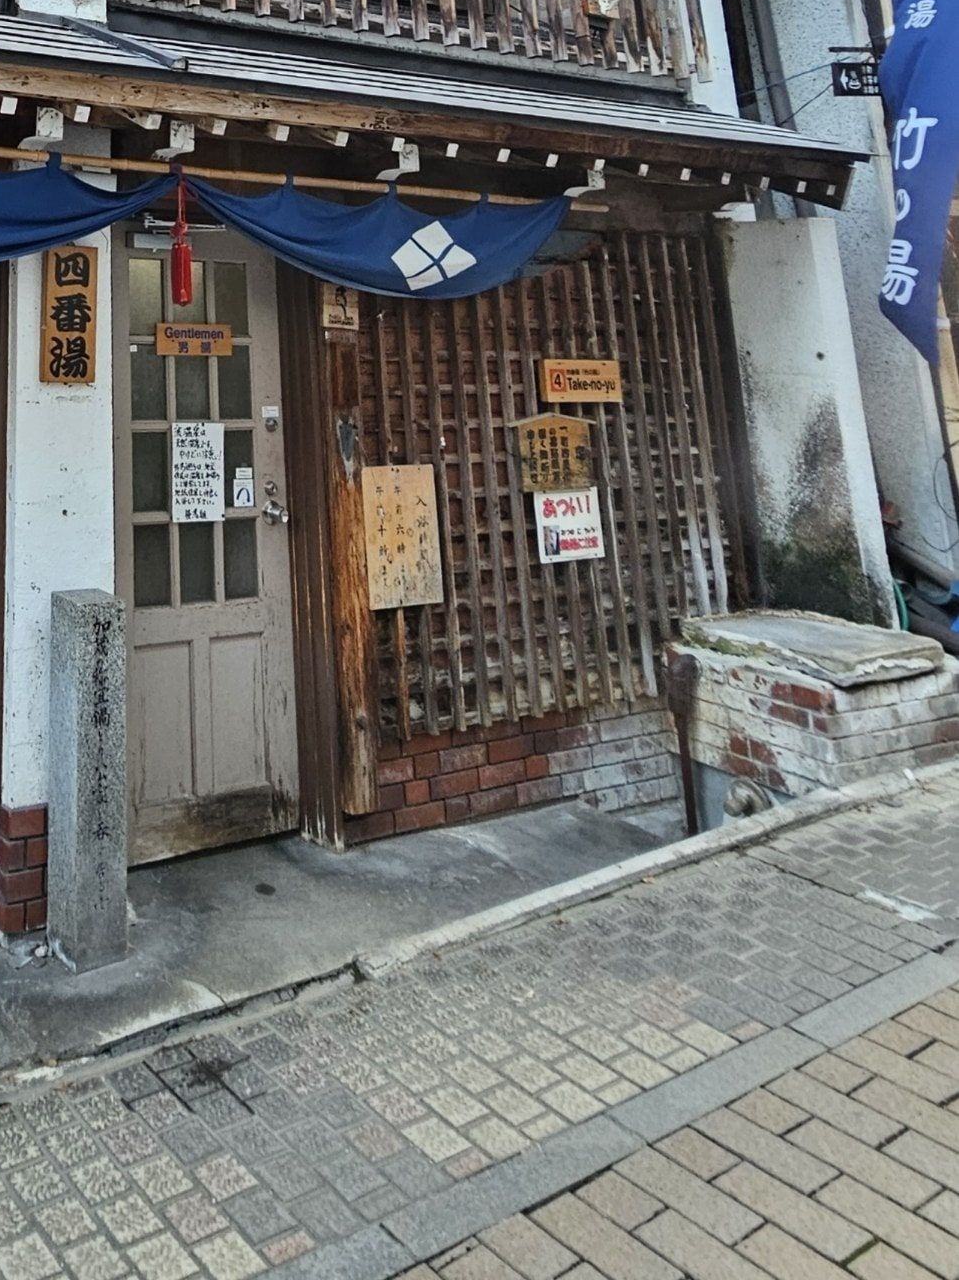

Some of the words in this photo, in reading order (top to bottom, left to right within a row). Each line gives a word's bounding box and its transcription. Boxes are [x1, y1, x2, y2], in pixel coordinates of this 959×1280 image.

[50, 252, 91, 379] 四番湯
[165, 327, 224, 339] Gentlemen
[554, 373, 562, 388] 4
[567, 377, 615, 394] Take-no-yu
